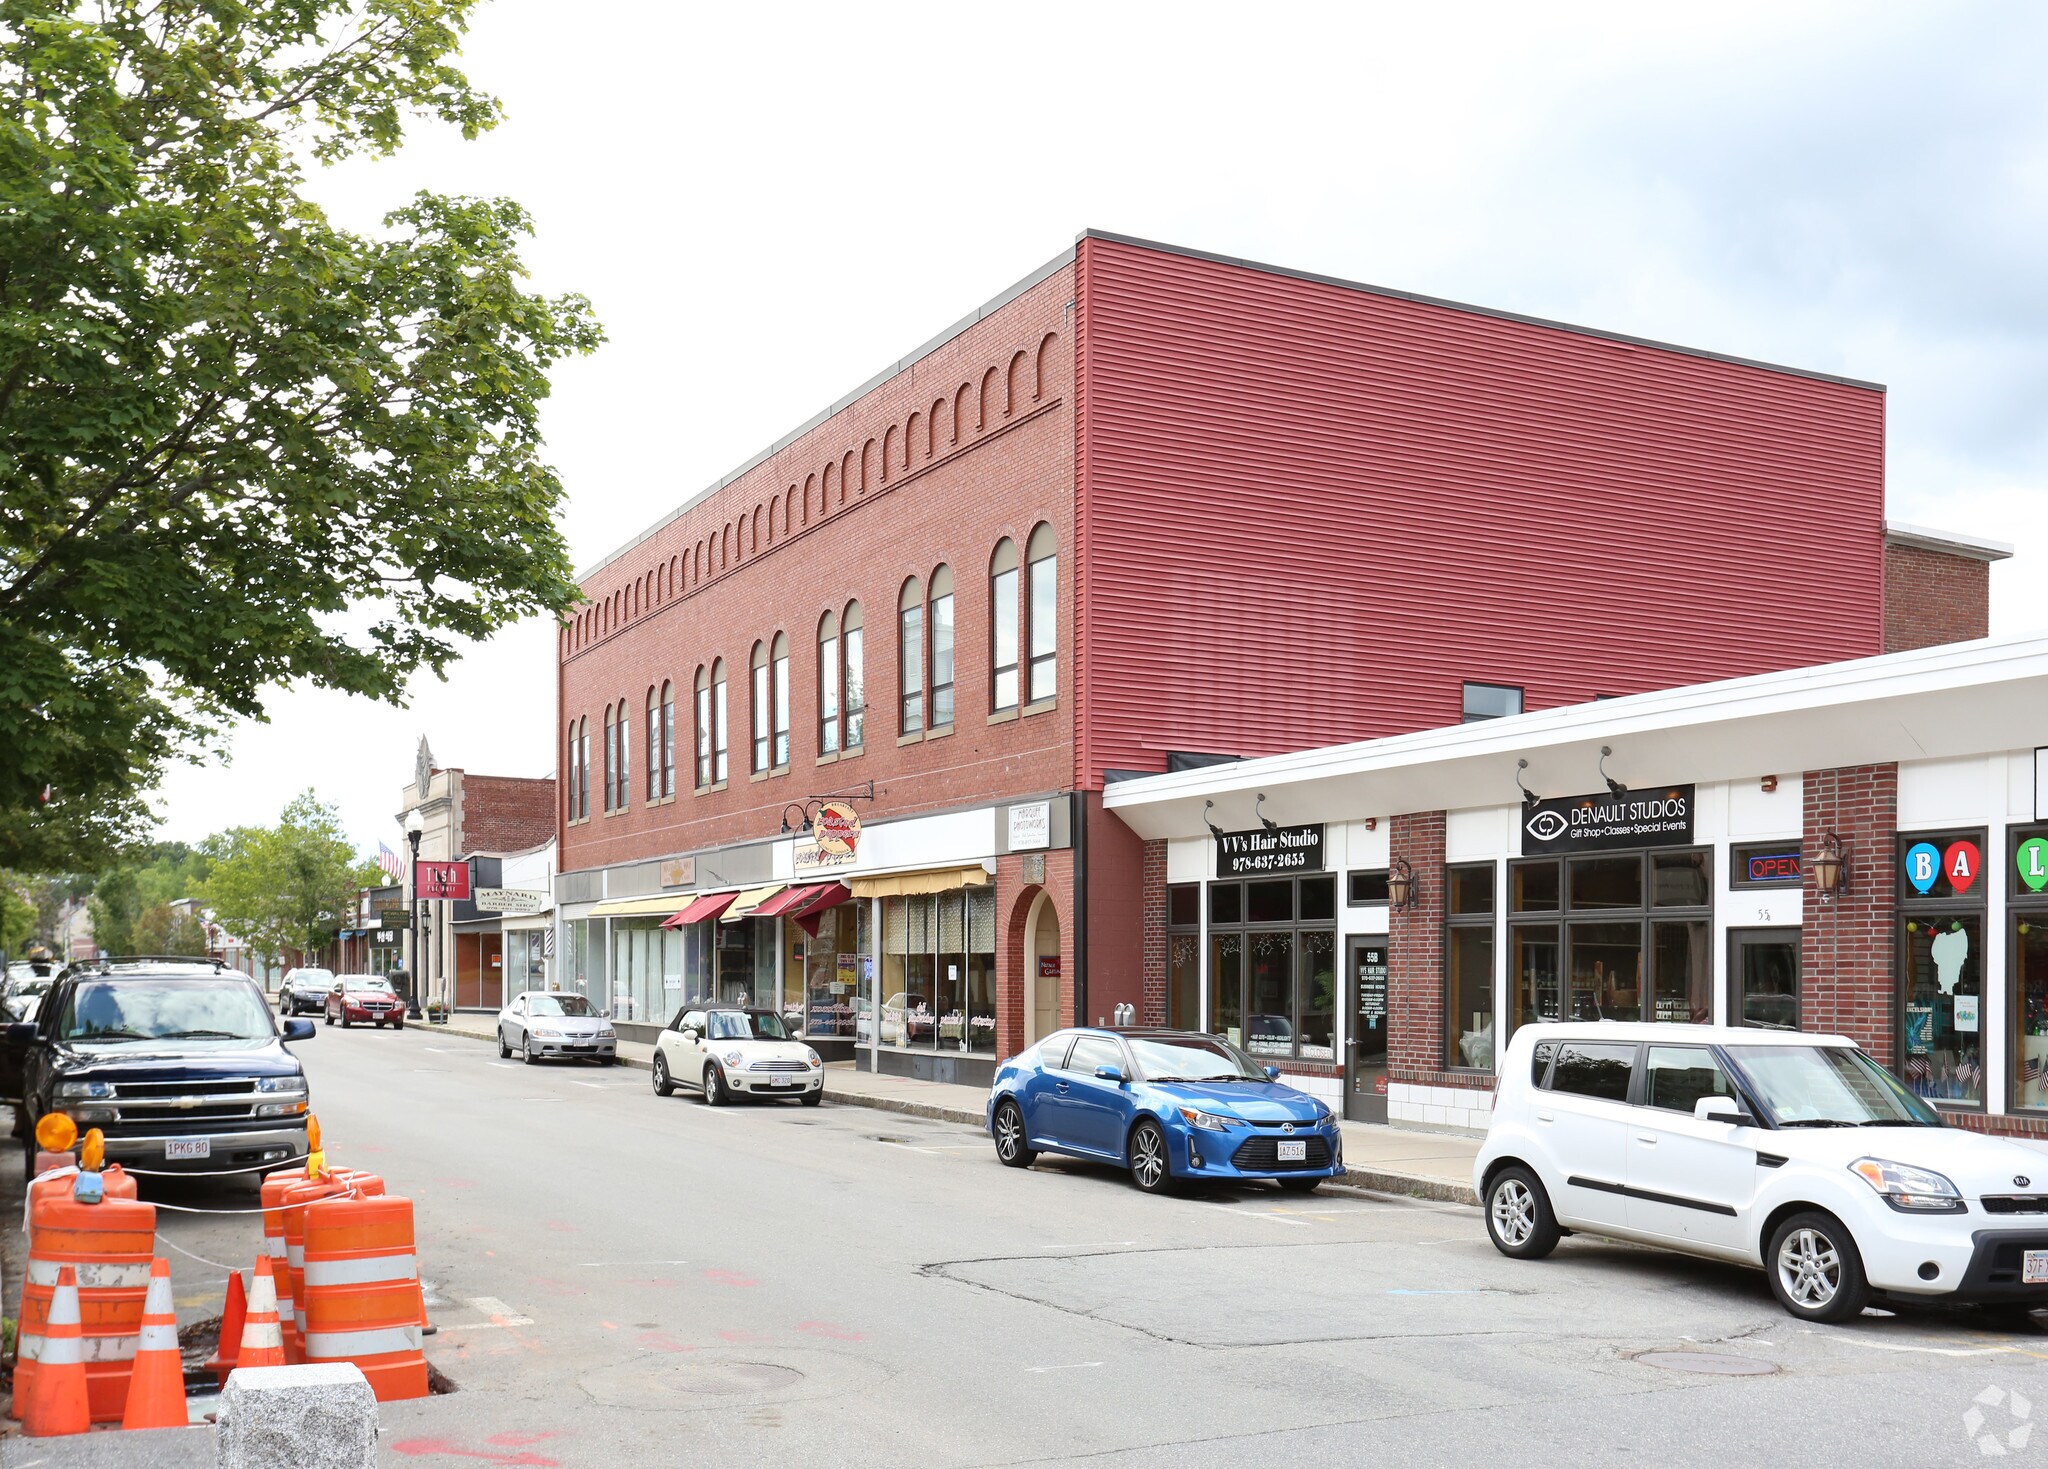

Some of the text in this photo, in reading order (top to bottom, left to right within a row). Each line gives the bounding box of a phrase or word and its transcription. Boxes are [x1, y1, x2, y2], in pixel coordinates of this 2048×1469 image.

[1571, 798, 1686, 826] DENAULT STUDIOS
[1570, 828, 1582, 839] Gift
[1662, 820, 1687, 831] Events
[1250, 834, 1277, 851] Hair
[1280, 829, 1318, 848] Studio
[1232, 852, 1305, 872] 978-637-2655
[1752, 858, 1800, 877] OPEN
[426, 867, 456, 883] Tish
[480, 890, 537, 900] MAYNARD
[1366, 952, 1379, 962] 55B
[168, 1142, 208, 1154] 1PKG 80
[1291, 1146, 1304, 1156] 516
[2014, 1176, 2029, 1186] KIA
[2026, 1258, 2044, 1273] 37F
